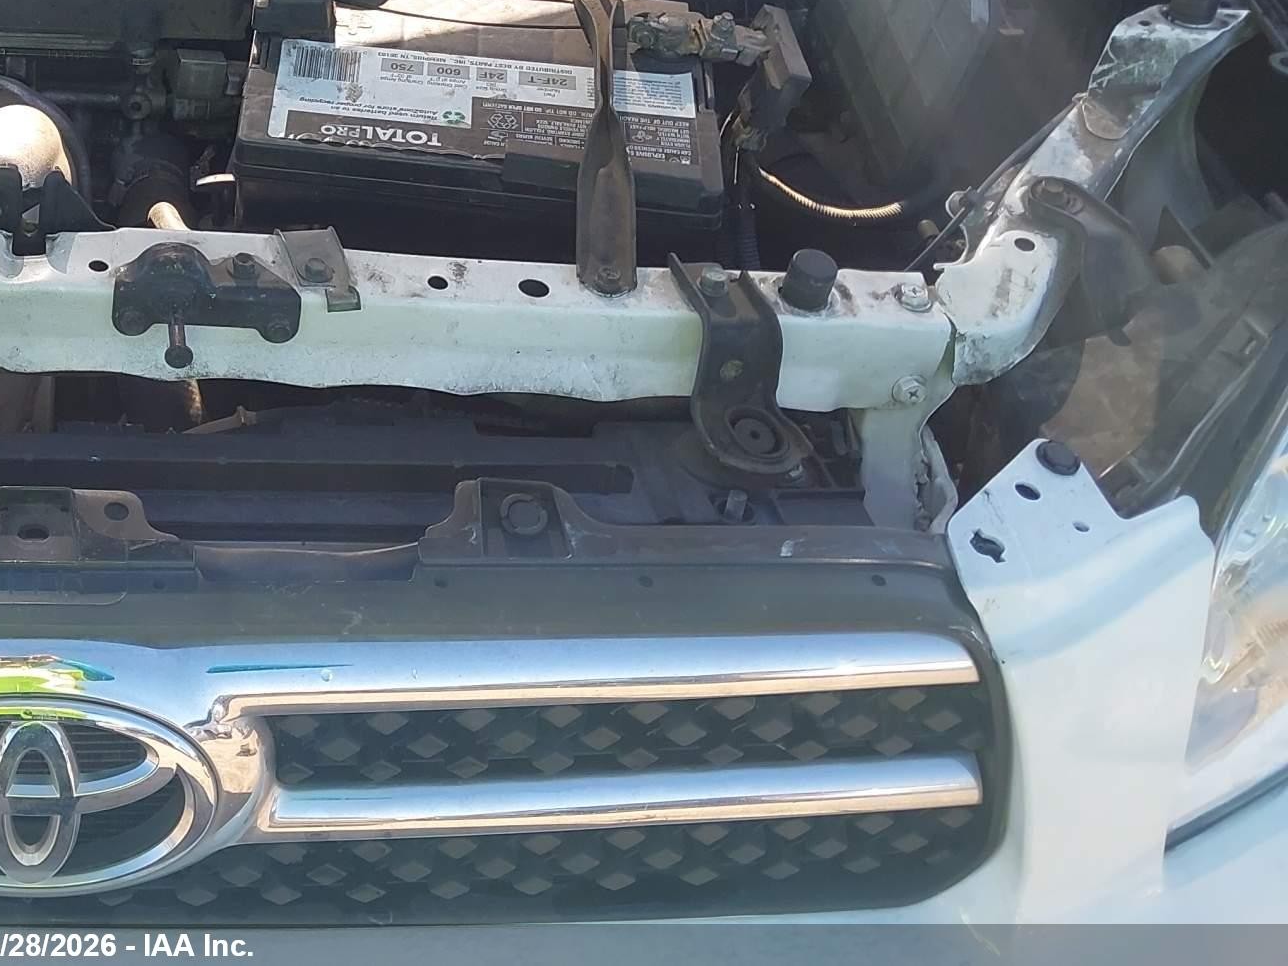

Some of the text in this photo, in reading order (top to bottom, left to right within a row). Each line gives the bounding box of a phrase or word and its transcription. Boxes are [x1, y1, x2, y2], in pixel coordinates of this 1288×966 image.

[390, 62, 414, 71] 750
[526, 66, 572, 74] DISTRIBUTED
[436, 67, 461, 76] 600
[479, 71, 504, 80] 24F
[528, 76, 567, 86] 24F-T
[320, 124, 442, 146] TOTALPRO
